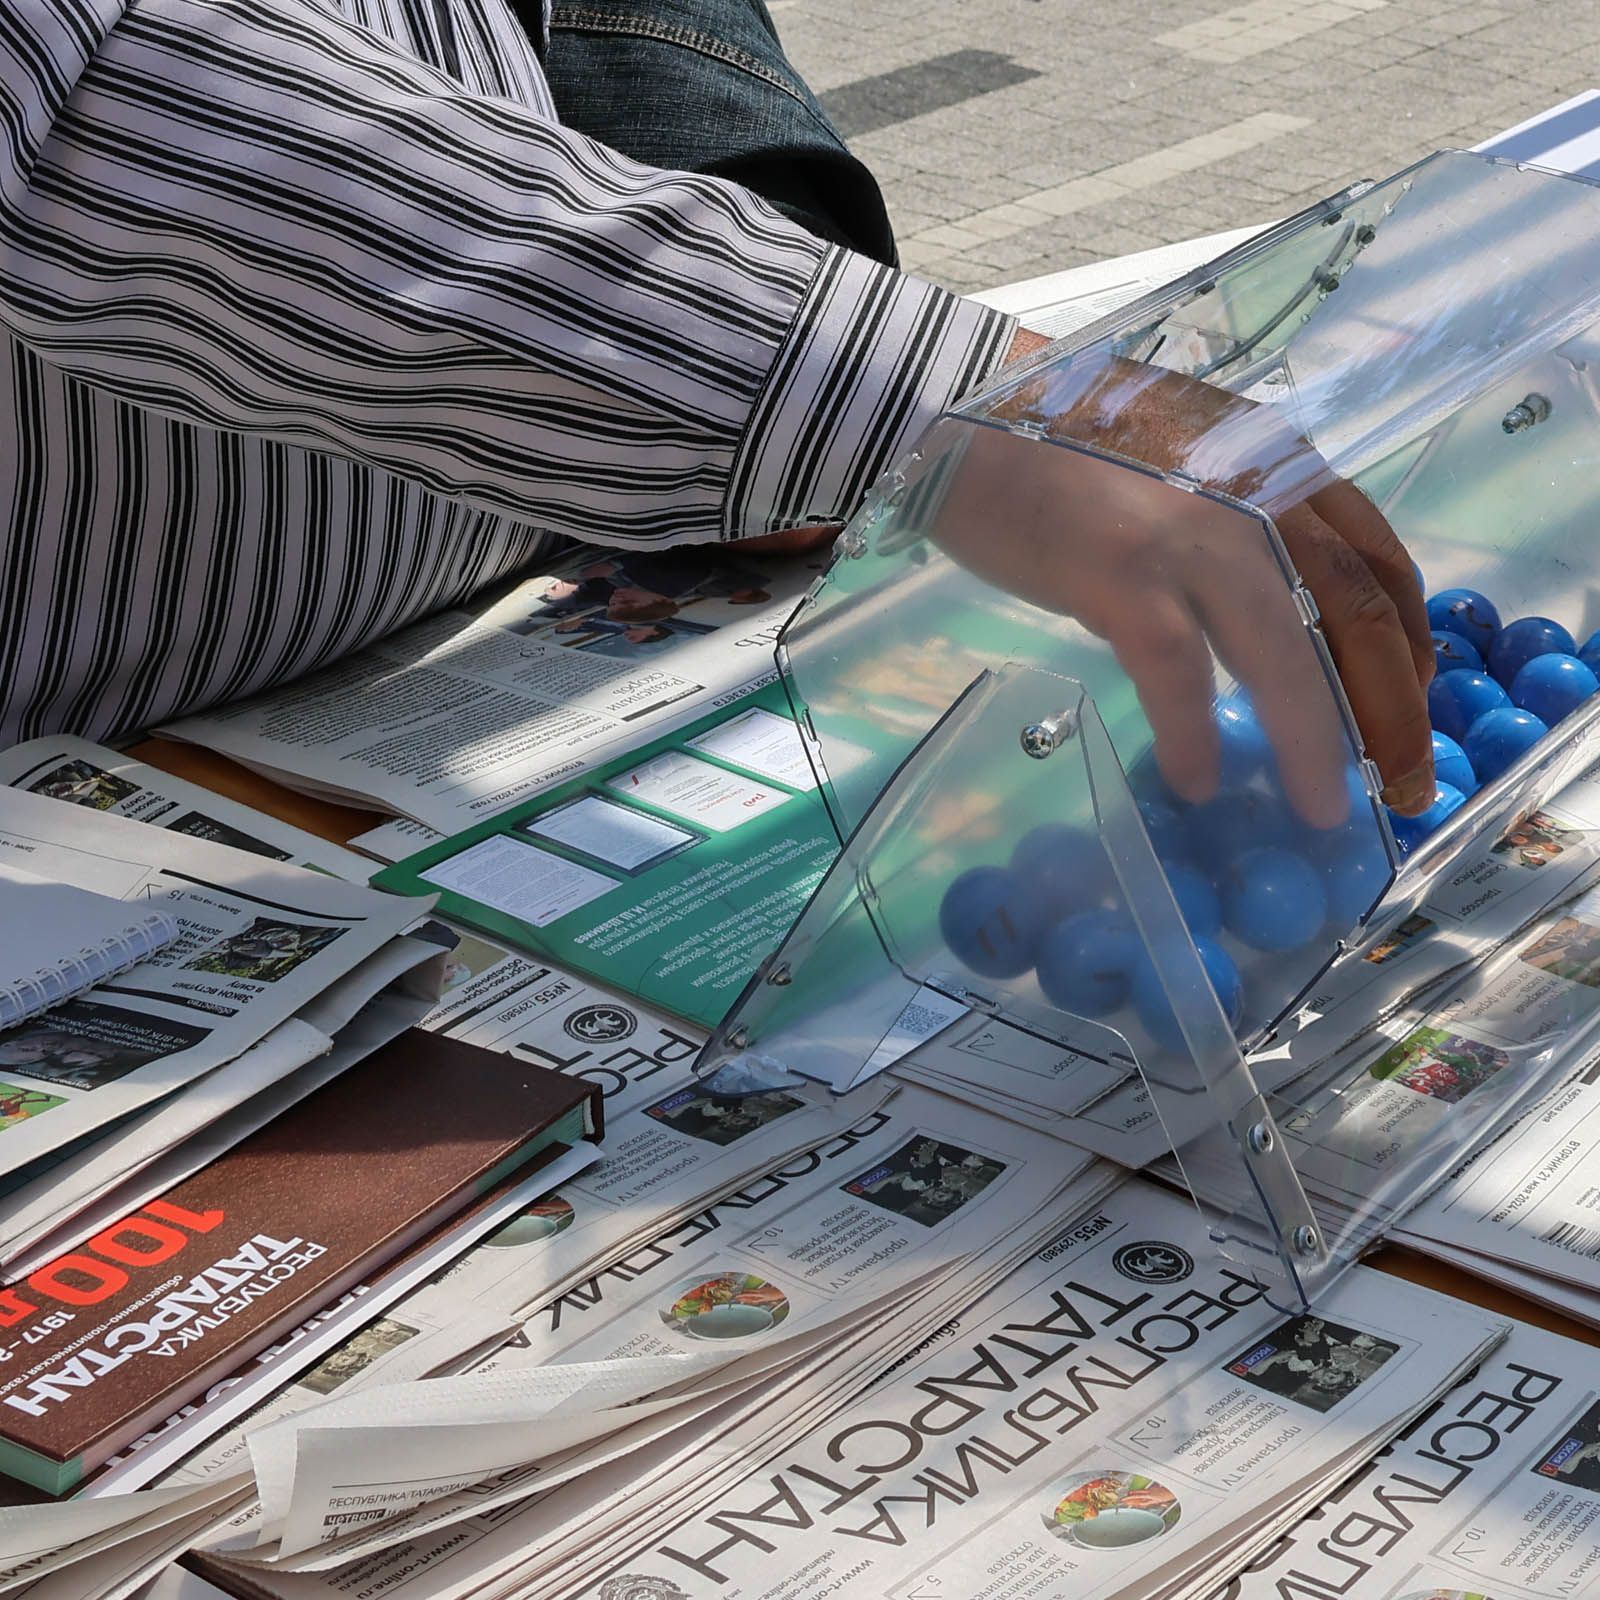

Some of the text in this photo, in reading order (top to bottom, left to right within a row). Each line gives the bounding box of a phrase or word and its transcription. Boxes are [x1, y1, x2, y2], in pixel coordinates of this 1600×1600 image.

[603, 676, 685, 712] Разделили
[609, 670, 667, 696] скорбь
[169, 978, 255, 1004] Закон вступил
[224, 978, 259, 992] силу
[497, 979, 571, 1025] №55 (29580)
[1503, 1139, 1582, 1210] ВТОРНИК 2024
[13, 1193, 239, 1310] 100
[760, 1225, 785, 1238] 10
[1035, 1215, 1115, 1262] №55 (29580)
[842, 1237, 911, 1279] программа
[0, 1228, 305, 1416] ТАТАРСТАН
[145, 1241, 330, 1359] РЕСПУБЛИКА
[25, 1274, 185, 1375] общественно-политическая
[829, 1267, 1275, 1553] РЕСПУБЛИКА
[1141, 1414, 1170, 1429] 10
[1200, 1387, 1249, 1416] эпизода
[1214, 1399, 1275, 1438] Чеснокова.
[646, 1270, 1153, 1585] ТАТАРСТАН
[1168, 1394, 1261, 1455] смешная королева
[1183, 1405, 1290, 1476] Гликерия Богданова-
[1216, 1425, 1307, 1486] программа TV
[1549, 1440, 1580, 1465] РОССИЯ
[1267, 1360, 1563, 1600] РЕСПУБЛИ
[1519, 1488, 1561, 1523] эпизода
[1463, 1525, 1488, 1541] 10
[1497, 1493, 1577, 1567] смешная королева
[1515, 1499, 1593, 1569] Чеснокова. Яркая,
[355, 1533, 468, 1600] www.rt-online.ru
[982, 1540, 1038, 1575] отходов
[1519, 1541, 1572, 1586] Богданова-
[1018, 1567, 1067, 1598] Казани
[1554, 1577, 1579, 1593] TV
